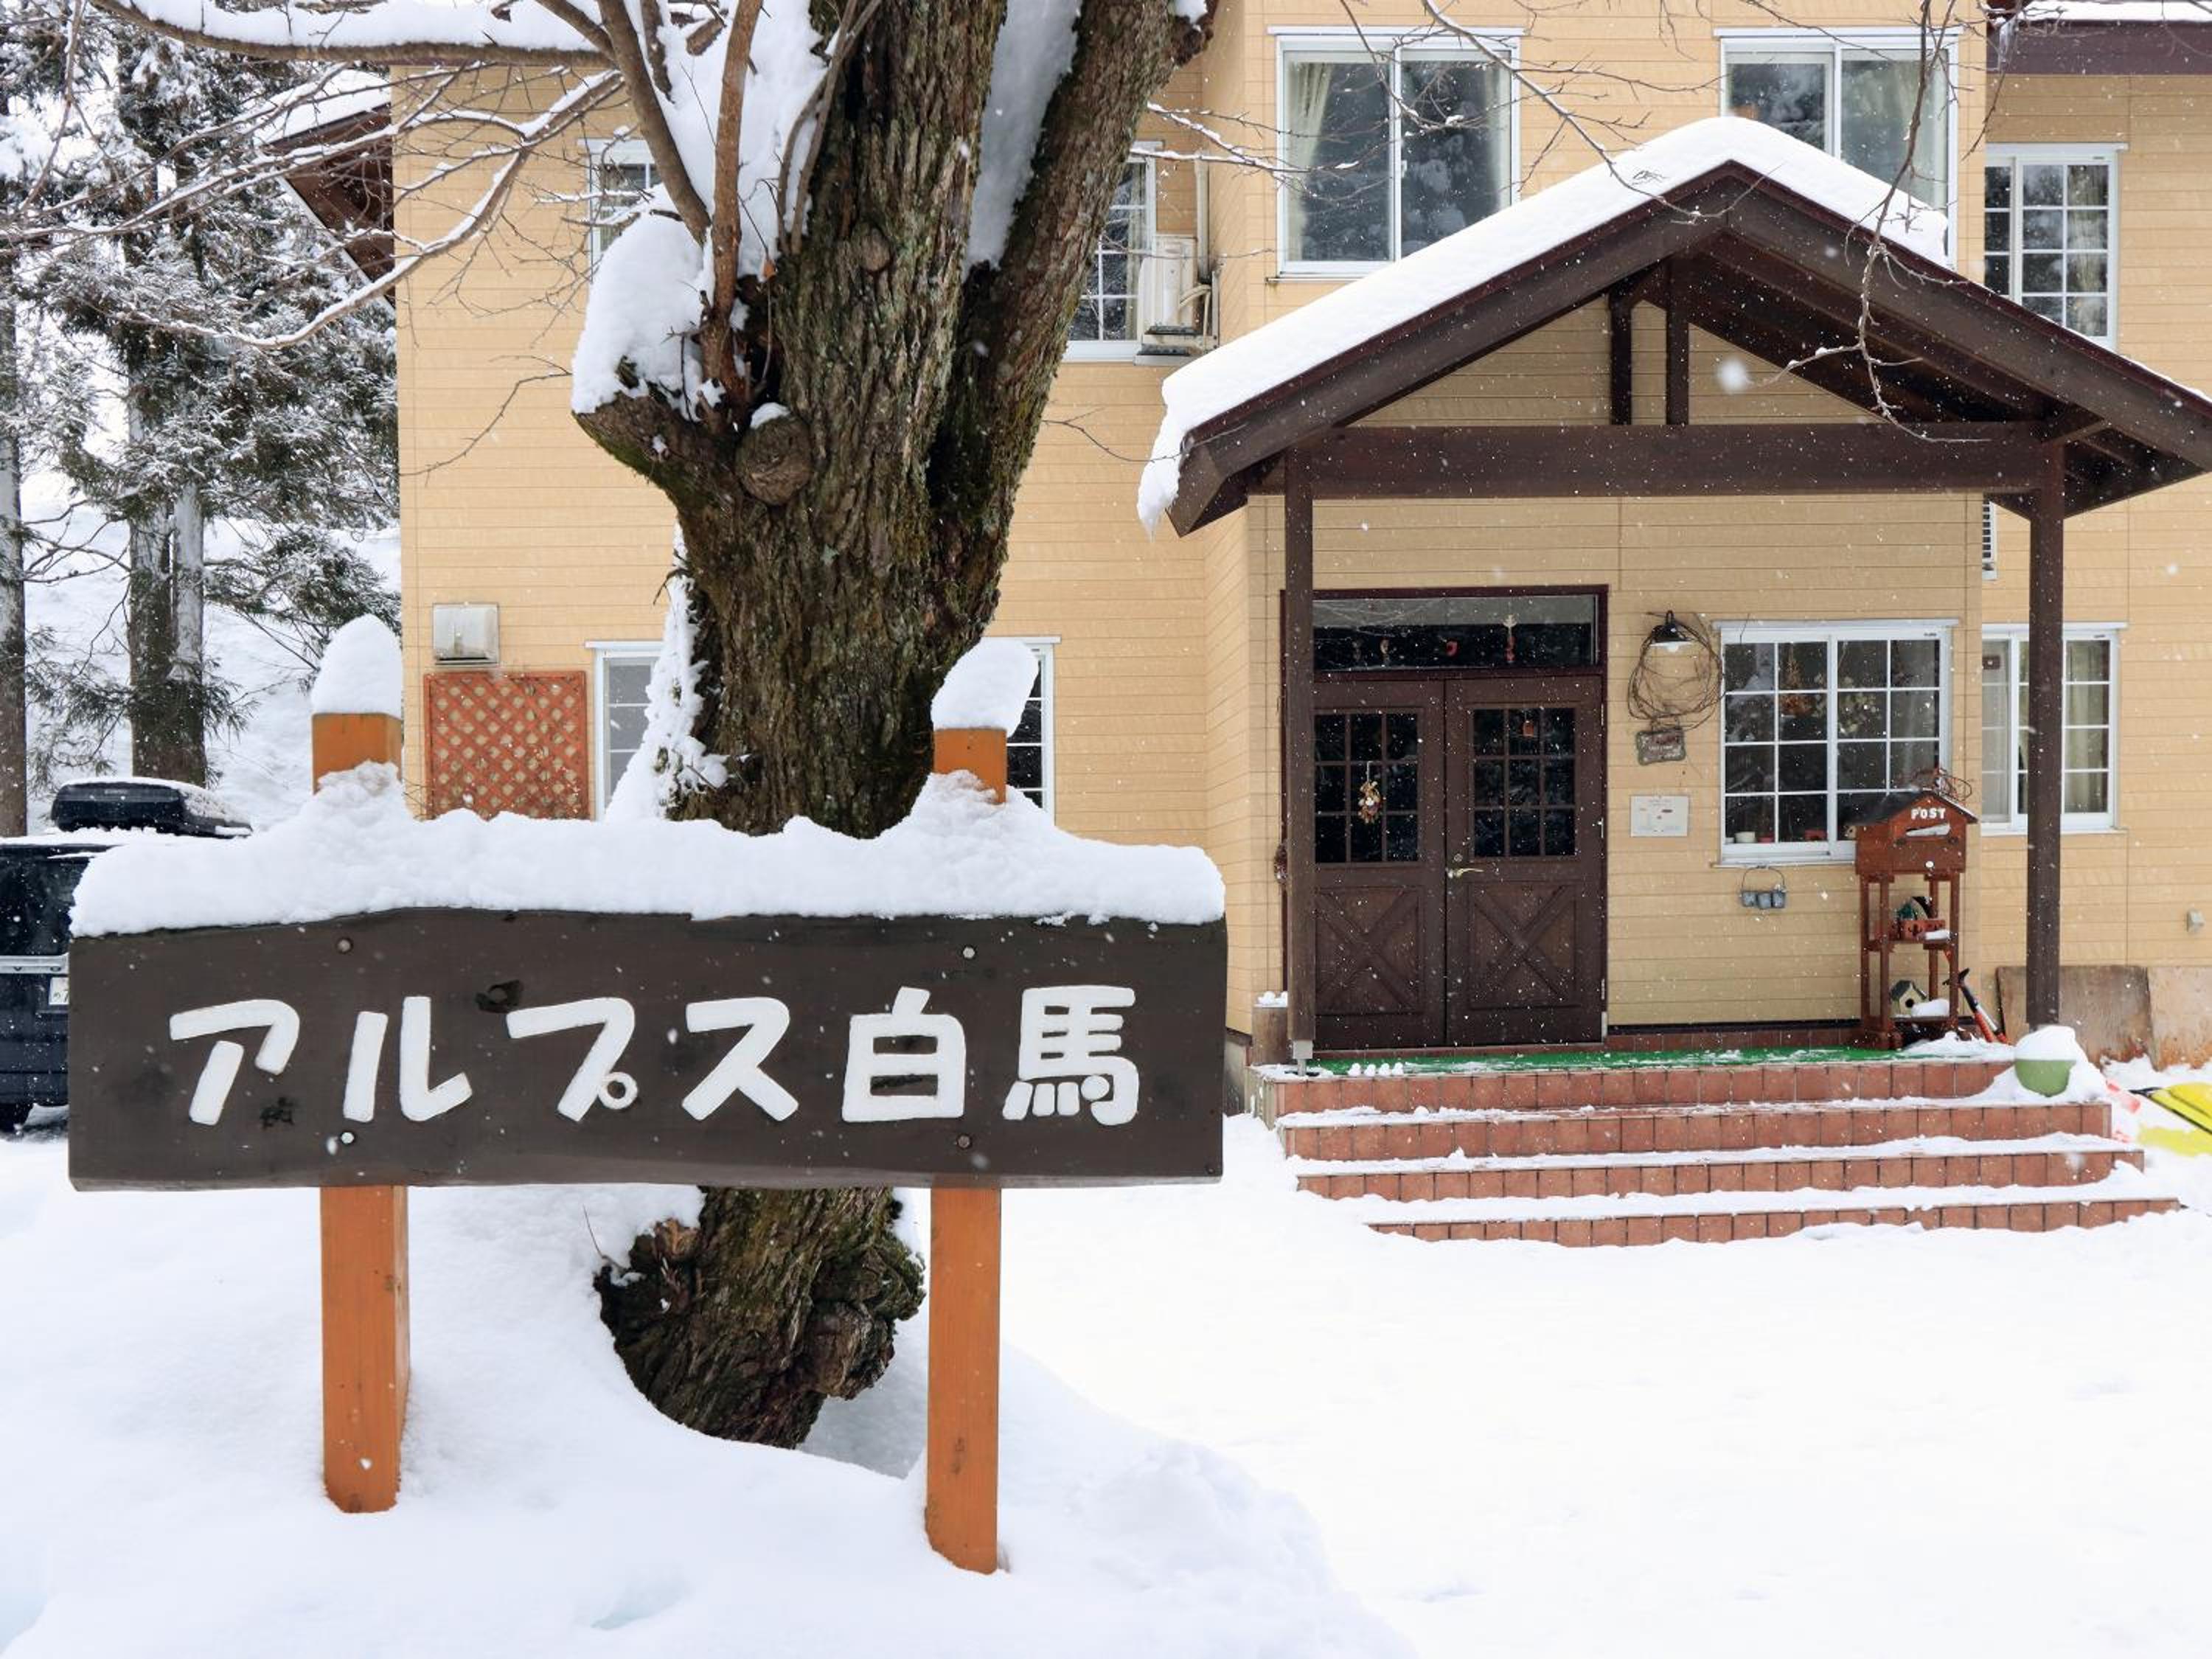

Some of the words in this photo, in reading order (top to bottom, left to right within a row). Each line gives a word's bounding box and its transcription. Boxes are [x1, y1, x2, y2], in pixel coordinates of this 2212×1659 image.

[1911, 807, 1946, 820] POST
[169, 984, 1140, 1126] アルプス白馬
